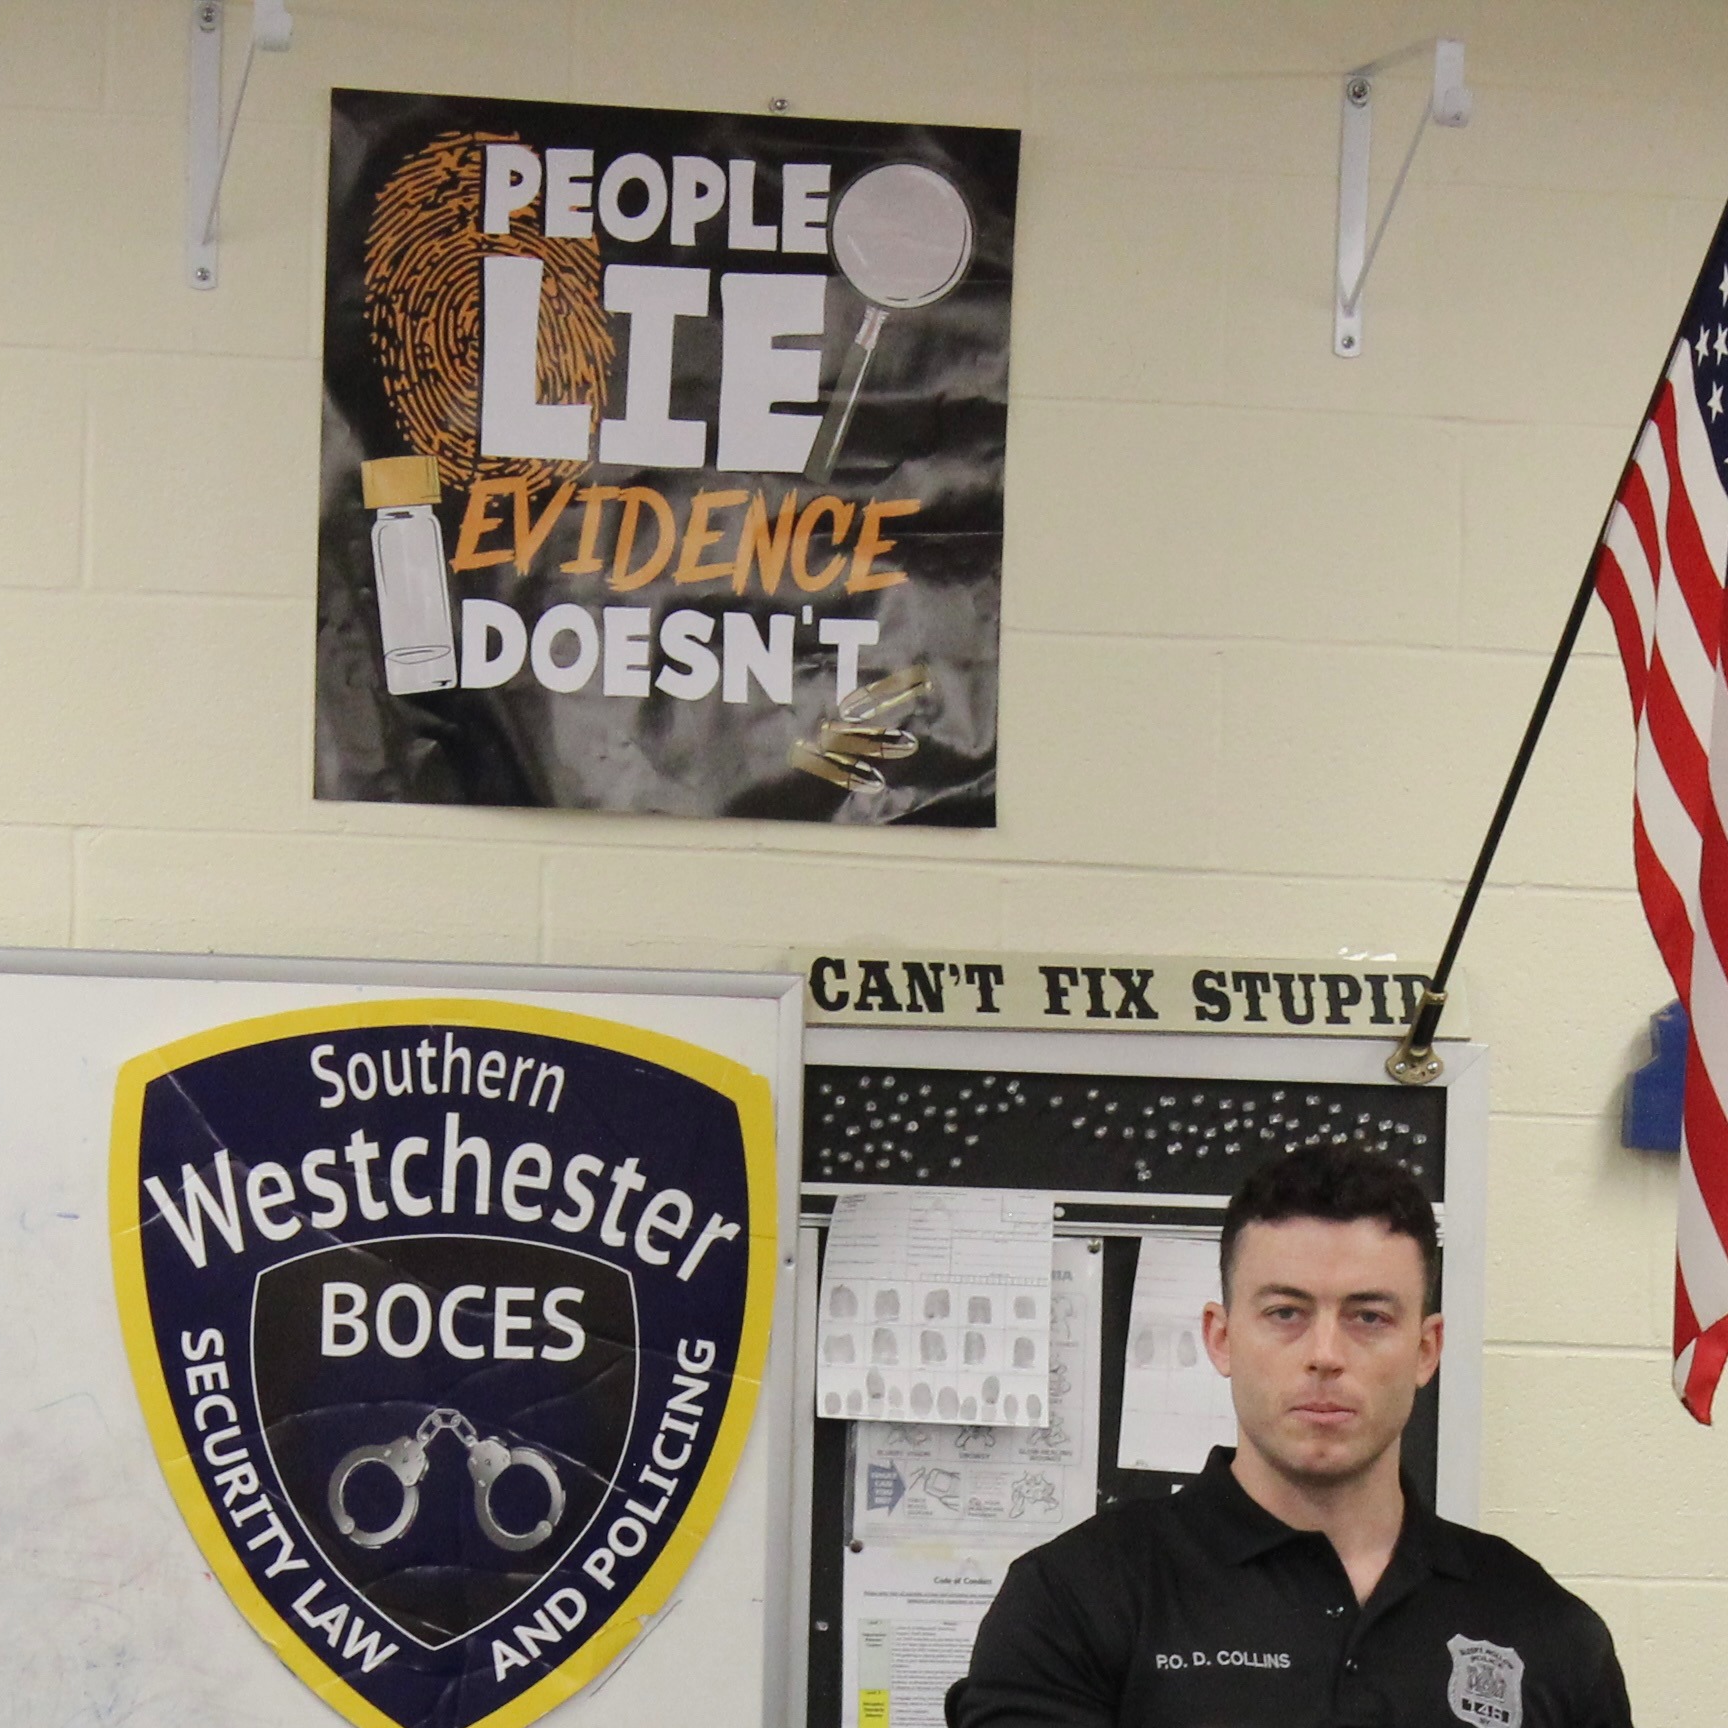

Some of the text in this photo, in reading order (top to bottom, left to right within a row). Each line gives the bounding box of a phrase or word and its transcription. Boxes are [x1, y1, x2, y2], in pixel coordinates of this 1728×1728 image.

[482, 144, 832, 254] PEOPLE
[480, 256, 827, 474] LIE
[450, 476, 922, 595] EVIDENCE
[460, 597, 879, 704] DOESN'T
[809, 955, 1004, 1014] CAN'T
[1039, 965, 1159, 1020] FIX
[310, 1031, 567, 1113] Southern
[144, 1111, 741, 1282] Westchester
[320, 1282, 587, 1362] BOCES
[181, 1327, 399, 1674] SECURITY LAW
[488, 1337, 716, 1682] AND POLICING
[1192, 1651, 1212, 1666] D.
[1217, 1650, 1291, 1669] COLLINS
